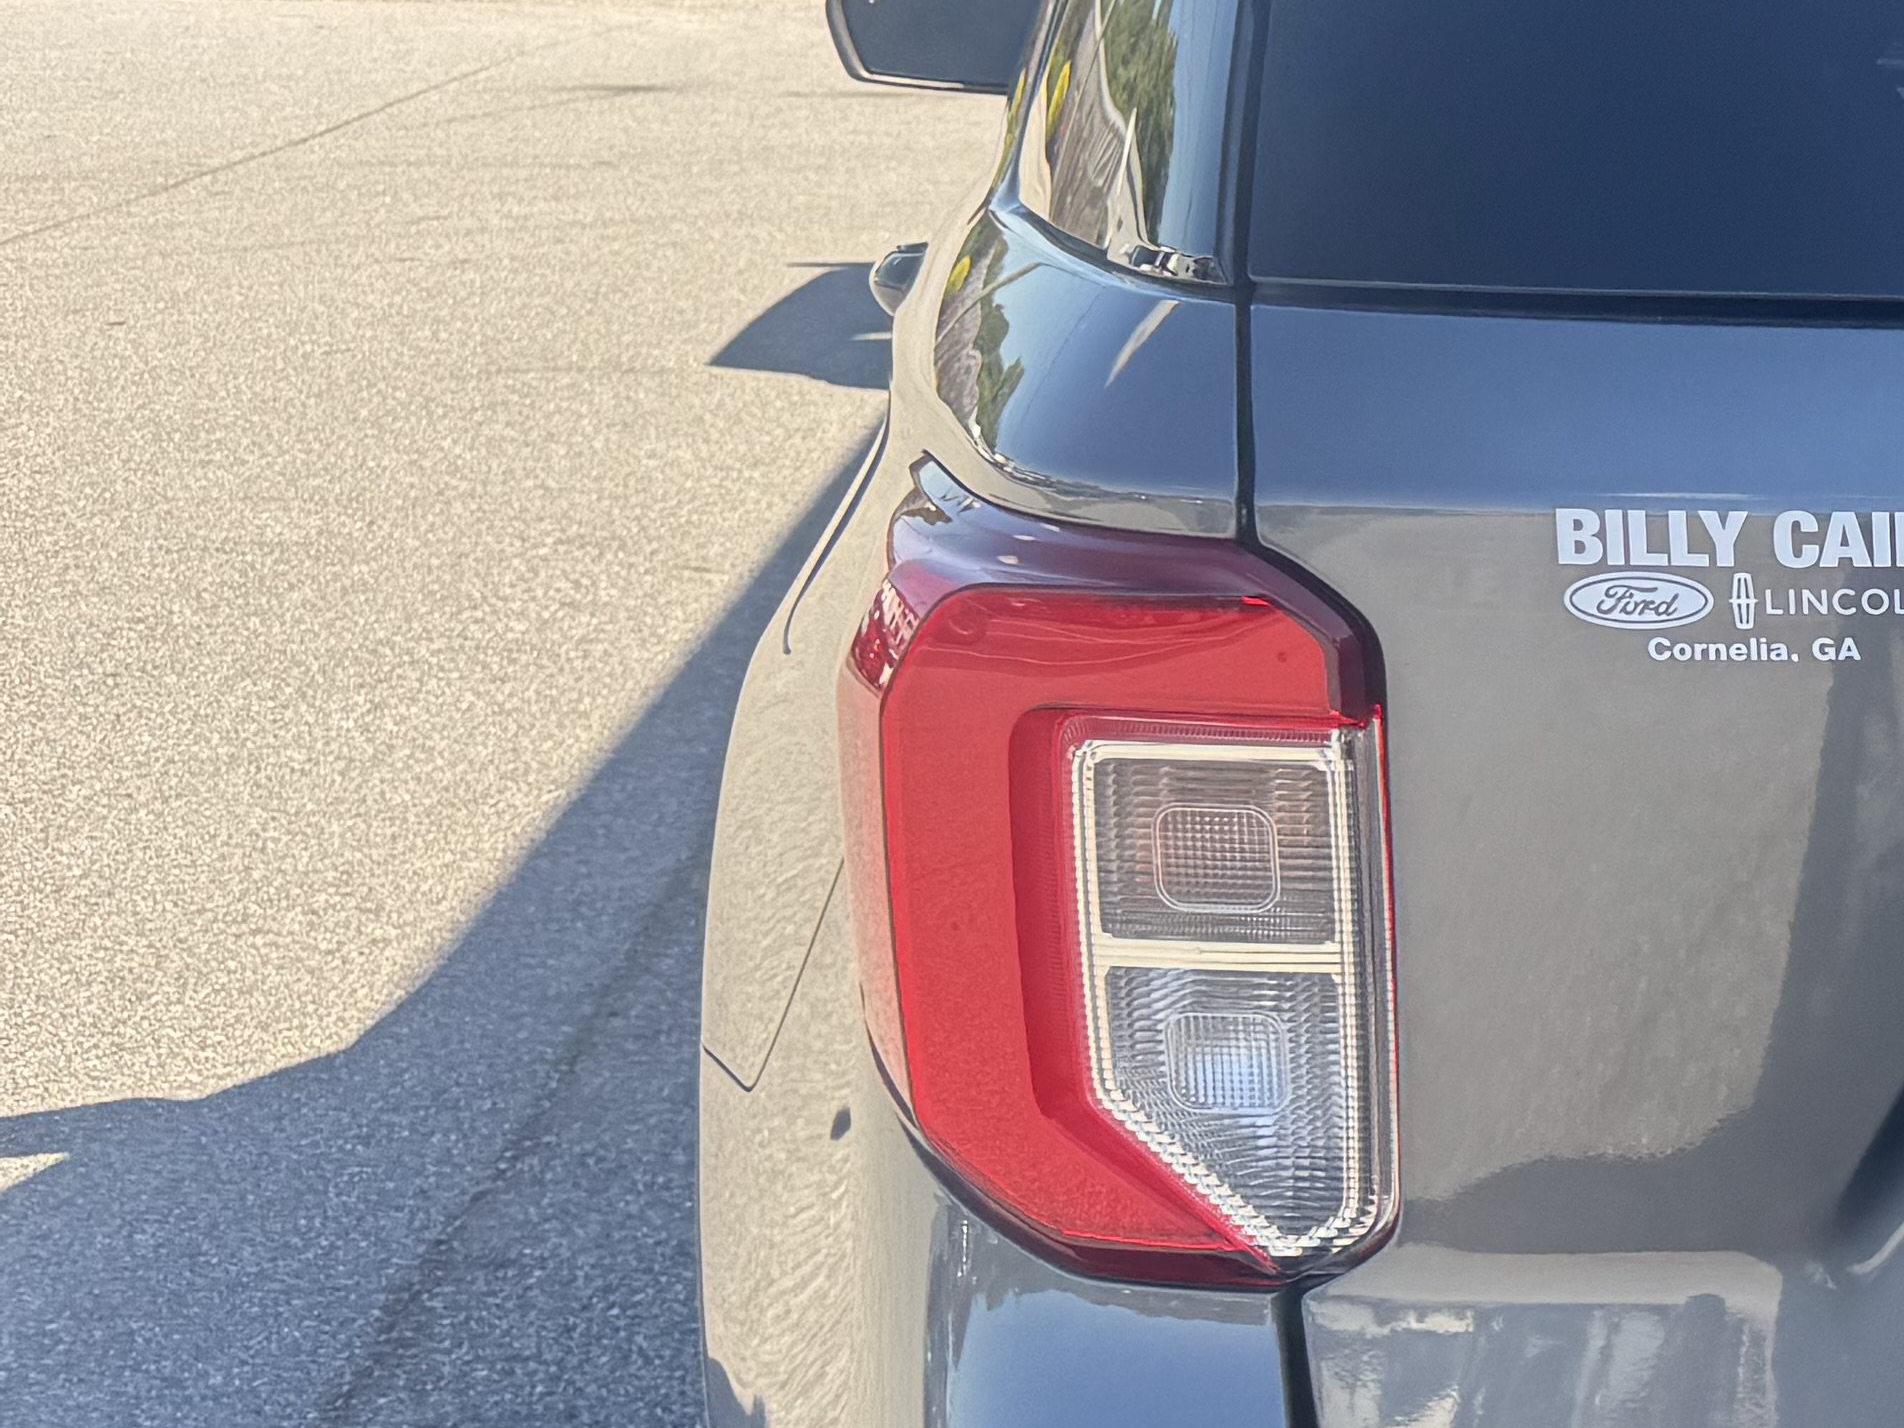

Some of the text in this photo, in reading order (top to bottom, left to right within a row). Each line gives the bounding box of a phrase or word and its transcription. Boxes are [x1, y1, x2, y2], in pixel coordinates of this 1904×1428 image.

[1555, 508, 1748, 567] BILLY
[1596, 584, 1680, 617] Ford
[1647, 637, 1861, 662] Cornelia, GA
